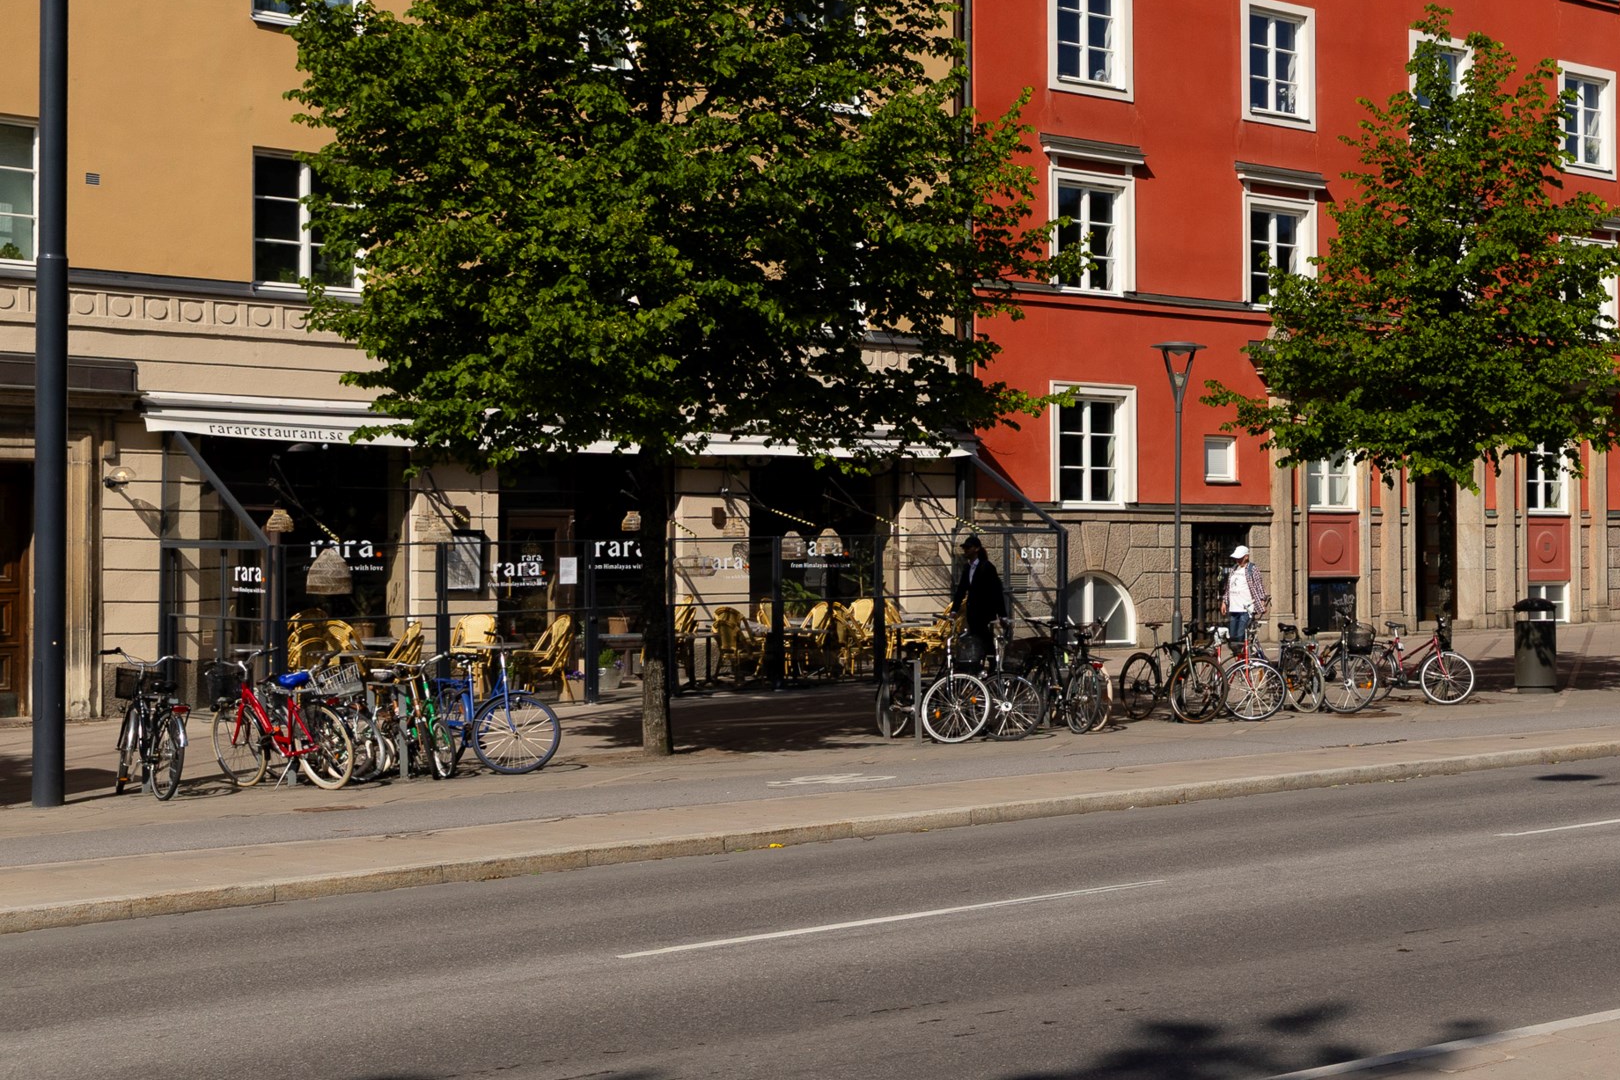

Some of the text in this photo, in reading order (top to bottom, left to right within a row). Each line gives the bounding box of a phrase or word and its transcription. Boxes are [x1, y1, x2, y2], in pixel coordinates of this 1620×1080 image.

[209, 423, 344, 440] rararestaurant.se
[521, 554, 544, 562] rara.
[235, 566, 266, 583] rara.
[491, 561, 546, 577] rara.
